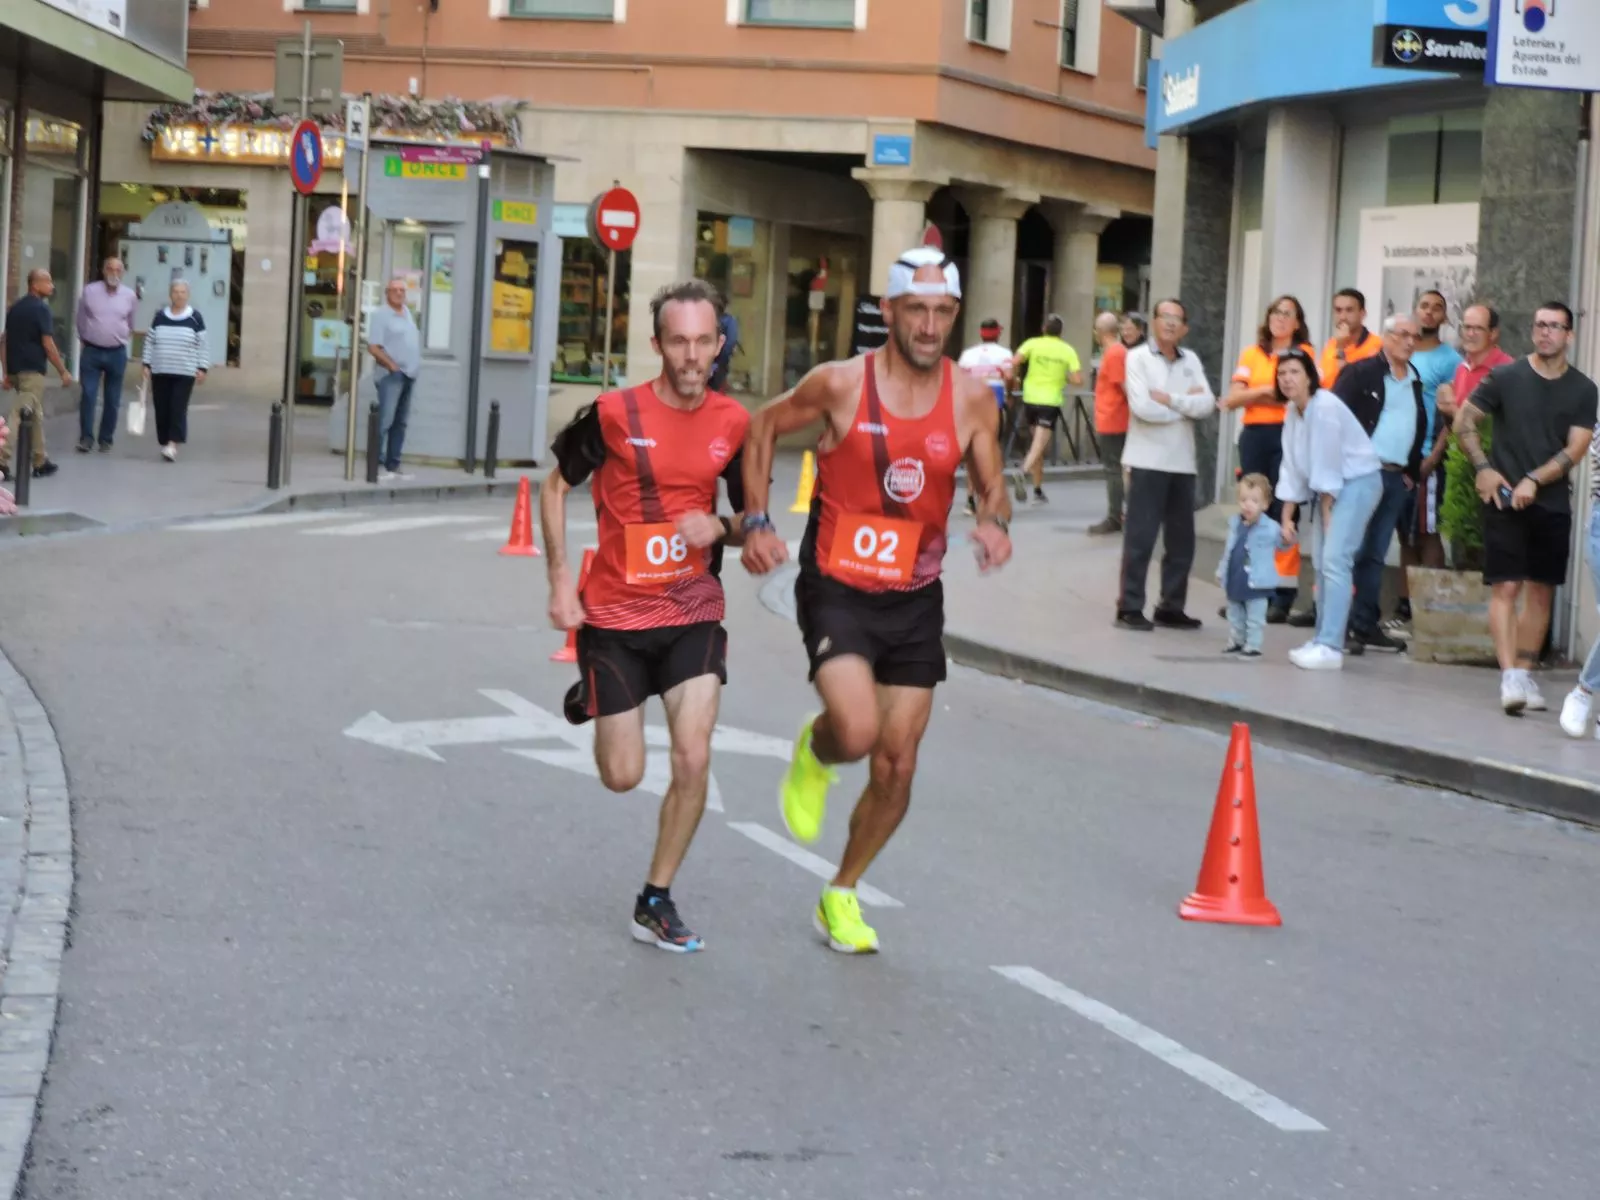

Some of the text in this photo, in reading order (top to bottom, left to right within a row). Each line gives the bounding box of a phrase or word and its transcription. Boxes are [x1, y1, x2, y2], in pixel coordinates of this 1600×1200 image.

[1424, 38, 1487, 60] ServiRe
[408, 162, 459, 177] ONCE
[646, 533, 688, 565] 08
[853, 525, 899, 563] 02
